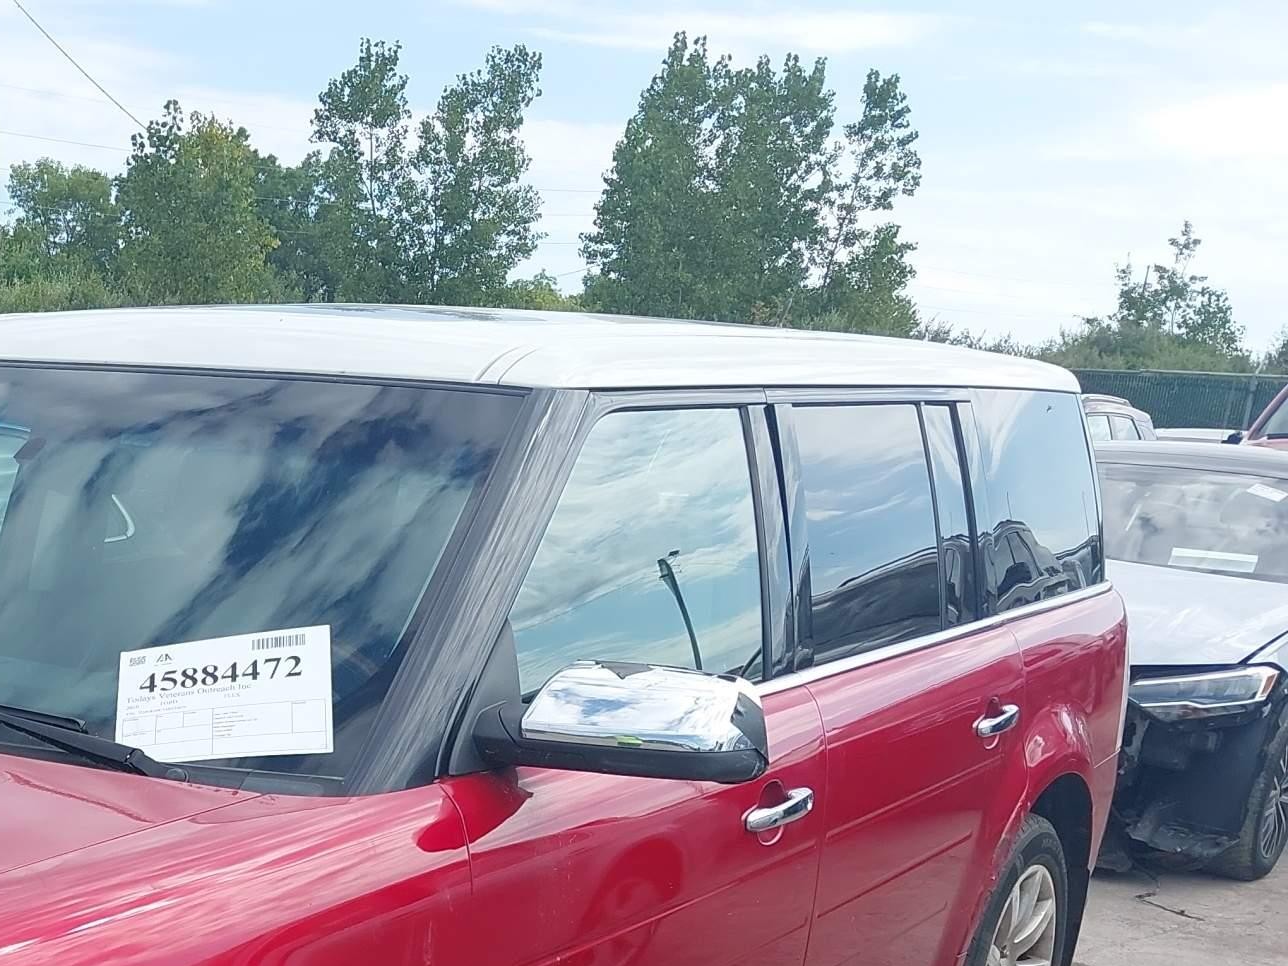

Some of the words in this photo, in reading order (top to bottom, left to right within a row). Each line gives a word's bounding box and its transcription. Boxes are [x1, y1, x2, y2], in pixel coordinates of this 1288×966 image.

[139, 655, 303, 693] 45884472
[159, 689, 195, 699] Veterans
[197, 684, 237, 695] Outreach
